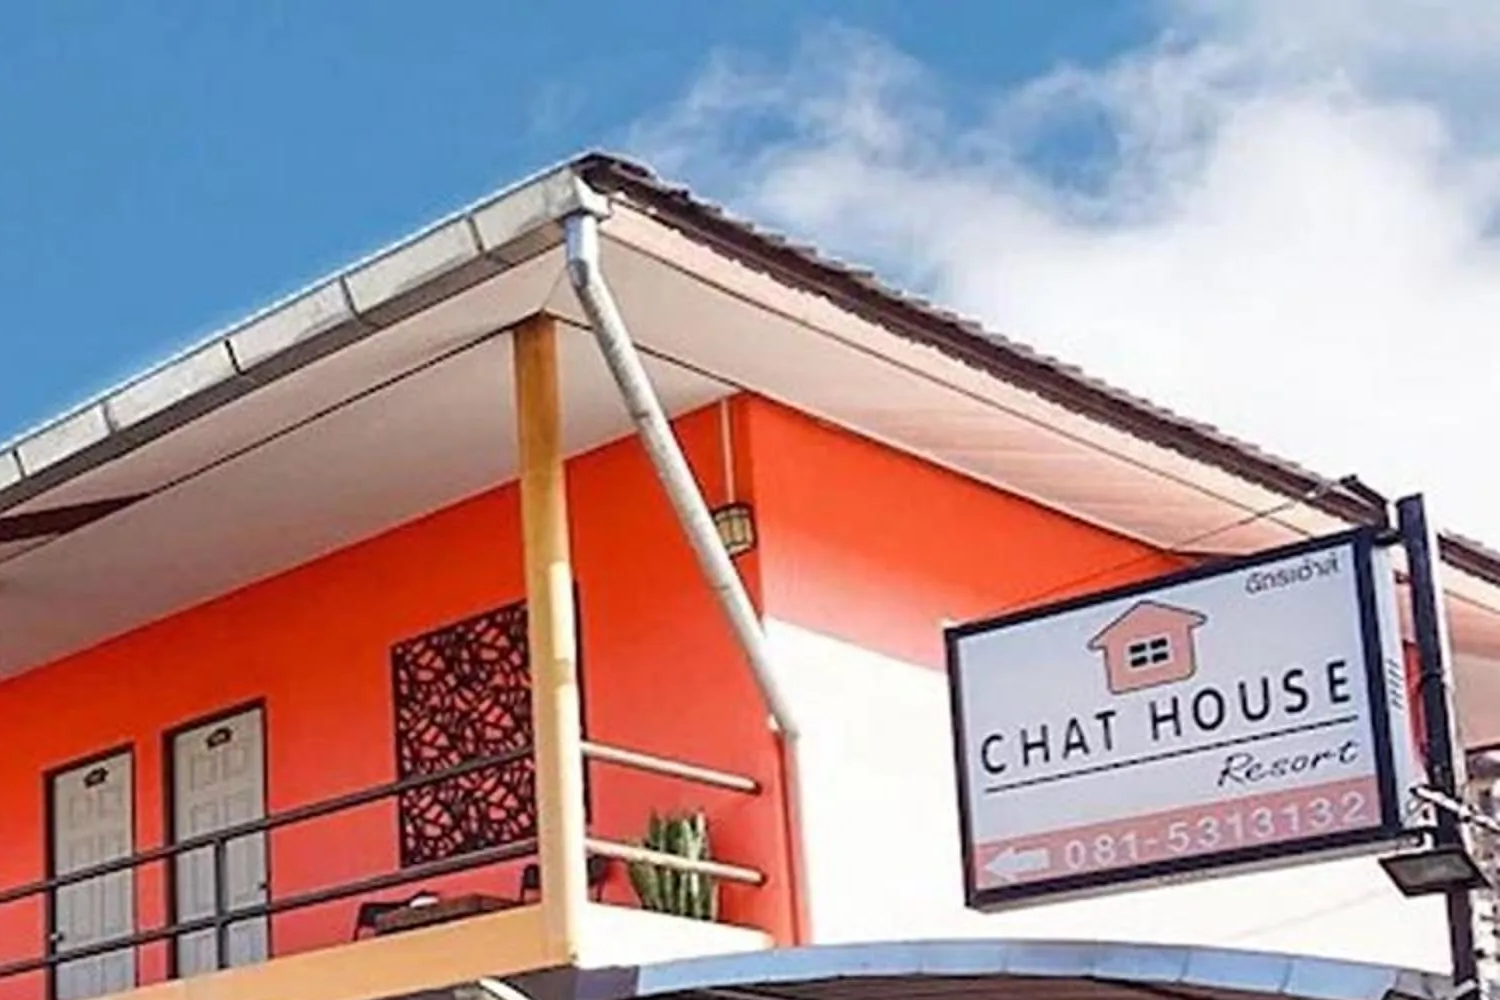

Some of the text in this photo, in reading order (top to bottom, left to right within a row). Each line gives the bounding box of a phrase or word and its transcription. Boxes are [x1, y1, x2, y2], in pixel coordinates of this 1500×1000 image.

[980, 659, 1353, 775] CHAT HOUSE
[1217, 740, 1359, 787] Resort
[1063, 791, 1368, 869] 081-5313132
